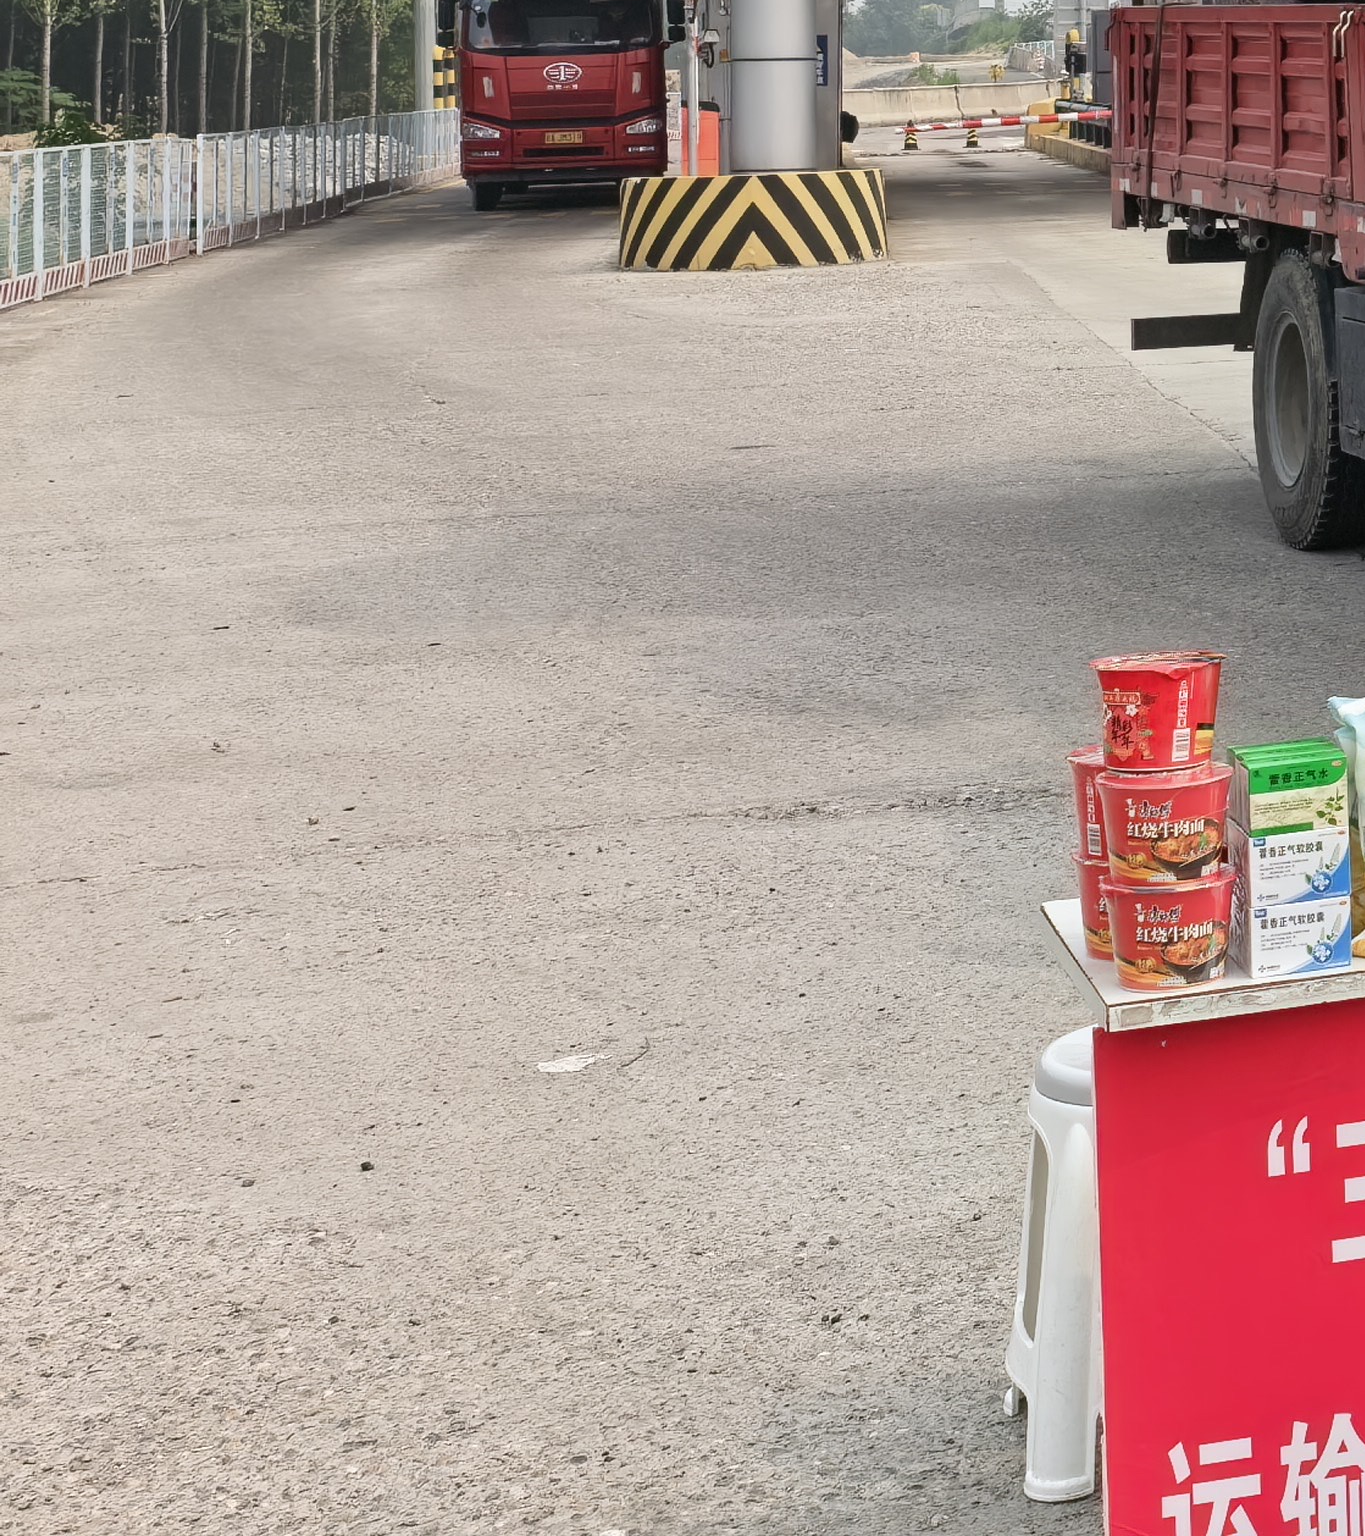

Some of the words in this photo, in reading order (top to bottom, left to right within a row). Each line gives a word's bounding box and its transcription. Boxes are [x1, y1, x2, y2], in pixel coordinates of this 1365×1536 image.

[1268, 767, 1329, 786] 藿香正气水
[1126, 817, 1206, 839] 红烧牛肉面
[1258, 840, 1324, 860] 藿香正气软胶囊
[1260, 911, 1325, 930] 藿香正气软胶囊
[1135, 920, 1214, 943] 红烧牛肉面
